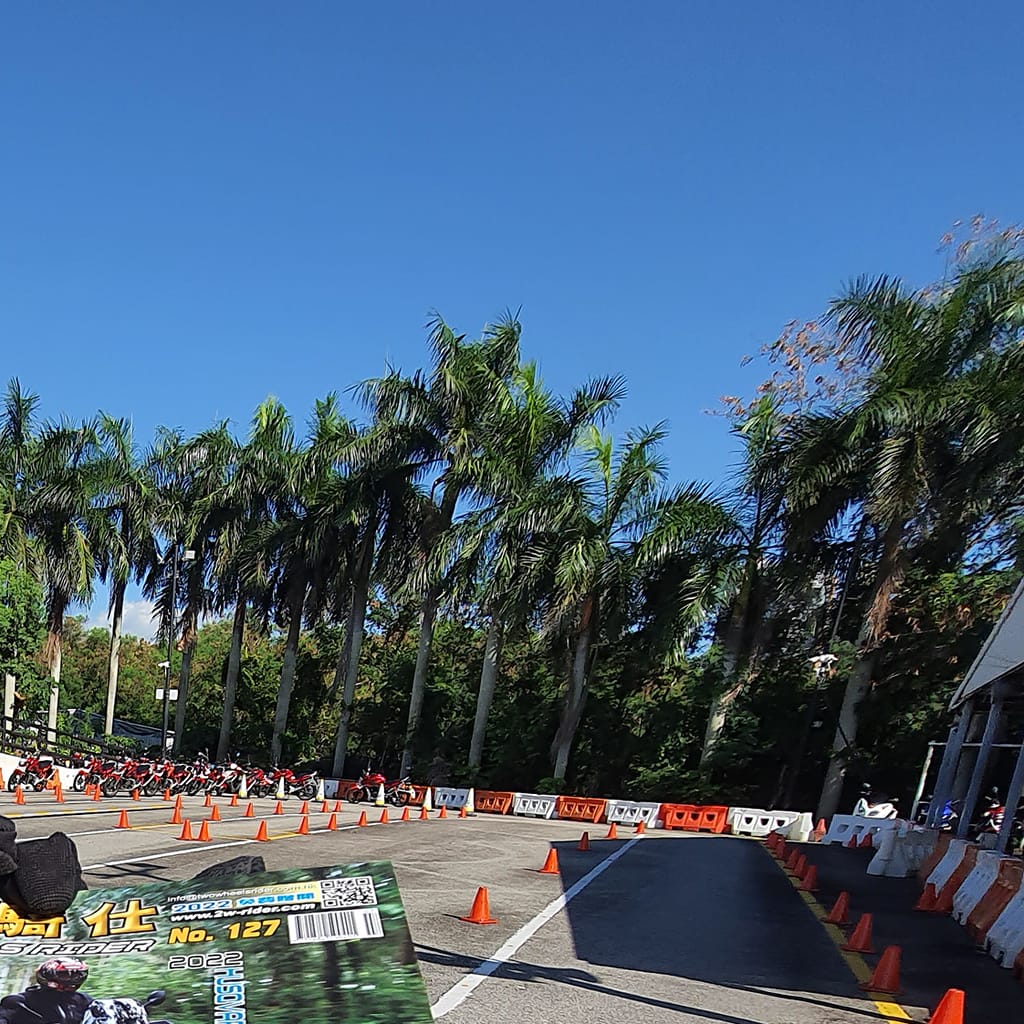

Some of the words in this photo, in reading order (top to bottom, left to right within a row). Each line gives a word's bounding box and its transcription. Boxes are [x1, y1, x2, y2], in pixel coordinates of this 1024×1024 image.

[170, 902, 316, 922] www.2w-rider.com
[172, 900, 231, 914] 2022
[168, 926, 214, 945] No.
[228, 918, 282, 940] 127
[26, 938, 157, 956] RIDER
[169, 951, 244, 969] 2022
